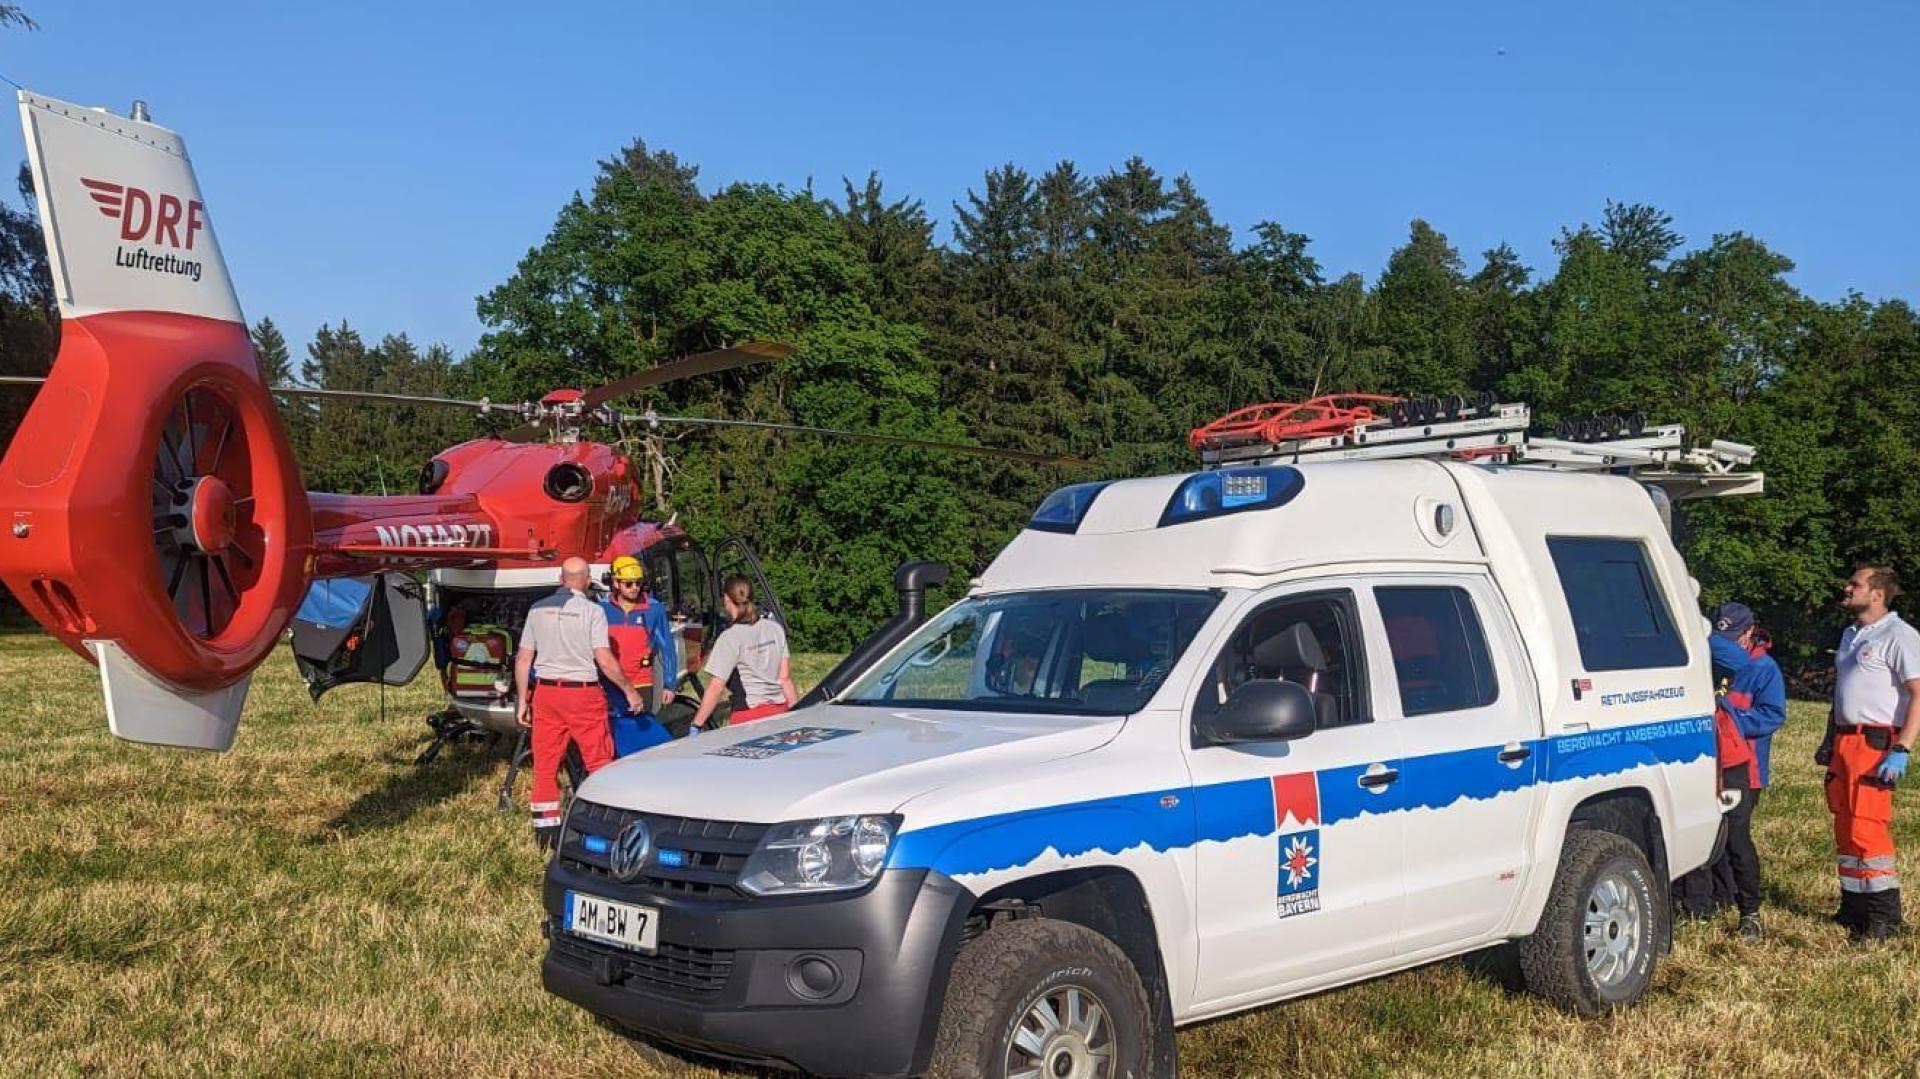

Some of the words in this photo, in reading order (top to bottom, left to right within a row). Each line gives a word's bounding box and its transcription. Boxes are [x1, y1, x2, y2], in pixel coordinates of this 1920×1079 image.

[120, 186, 204, 250] DRF
[115, 246, 202, 282] Luftrettung
[1600, 686, 1685, 706] RETTUNGSFAHRZEUG
[1557, 731, 1622, 754] BERGWACHT
[579, 900, 599, 931] AM
[607, 906, 628, 938] BW
[638, 912, 648, 942] 7
[1278, 897, 1320, 917] BAYERN
